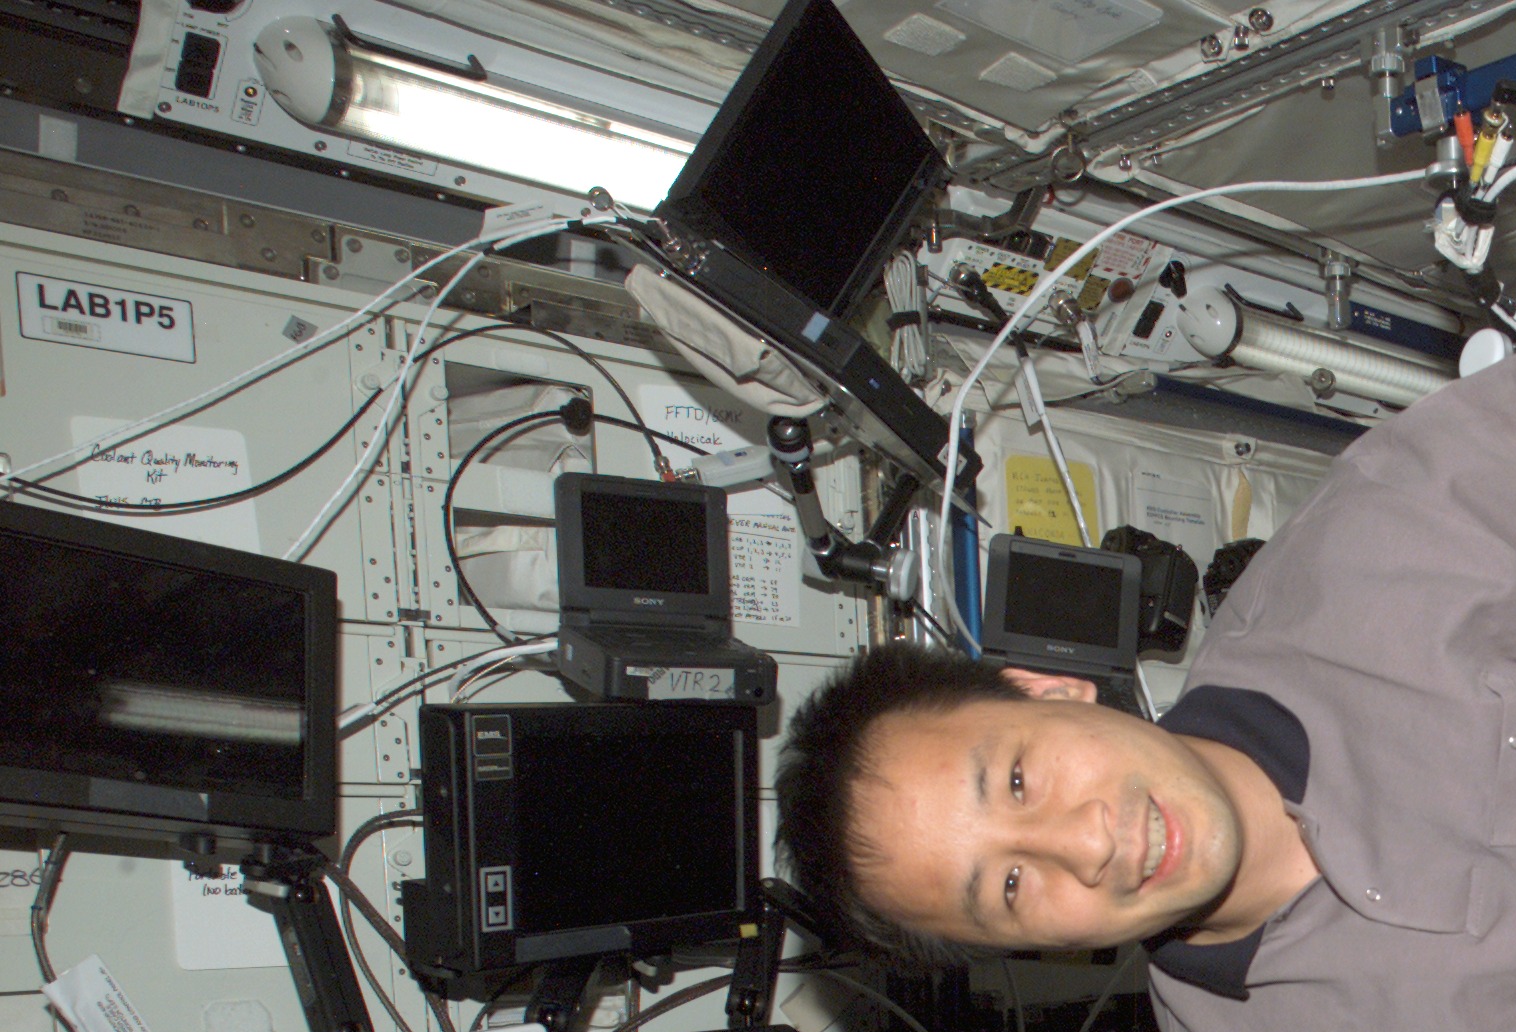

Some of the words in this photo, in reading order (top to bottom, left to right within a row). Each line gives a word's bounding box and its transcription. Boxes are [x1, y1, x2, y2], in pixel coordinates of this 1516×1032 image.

[37, 283, 176, 330] LAB1P5
[91, 443, 136, 464] Coolant
[140, 450, 181, 473] Quality
[183, 452, 239, 475] Monitoring
[146, 469, 168, 484] Kit
[633, 597, 664, 606] SONY
[1046, 644, 1075, 654] SONY
[670, 670, 704, 692] VTR
[709, 674, 724, 693] 2
